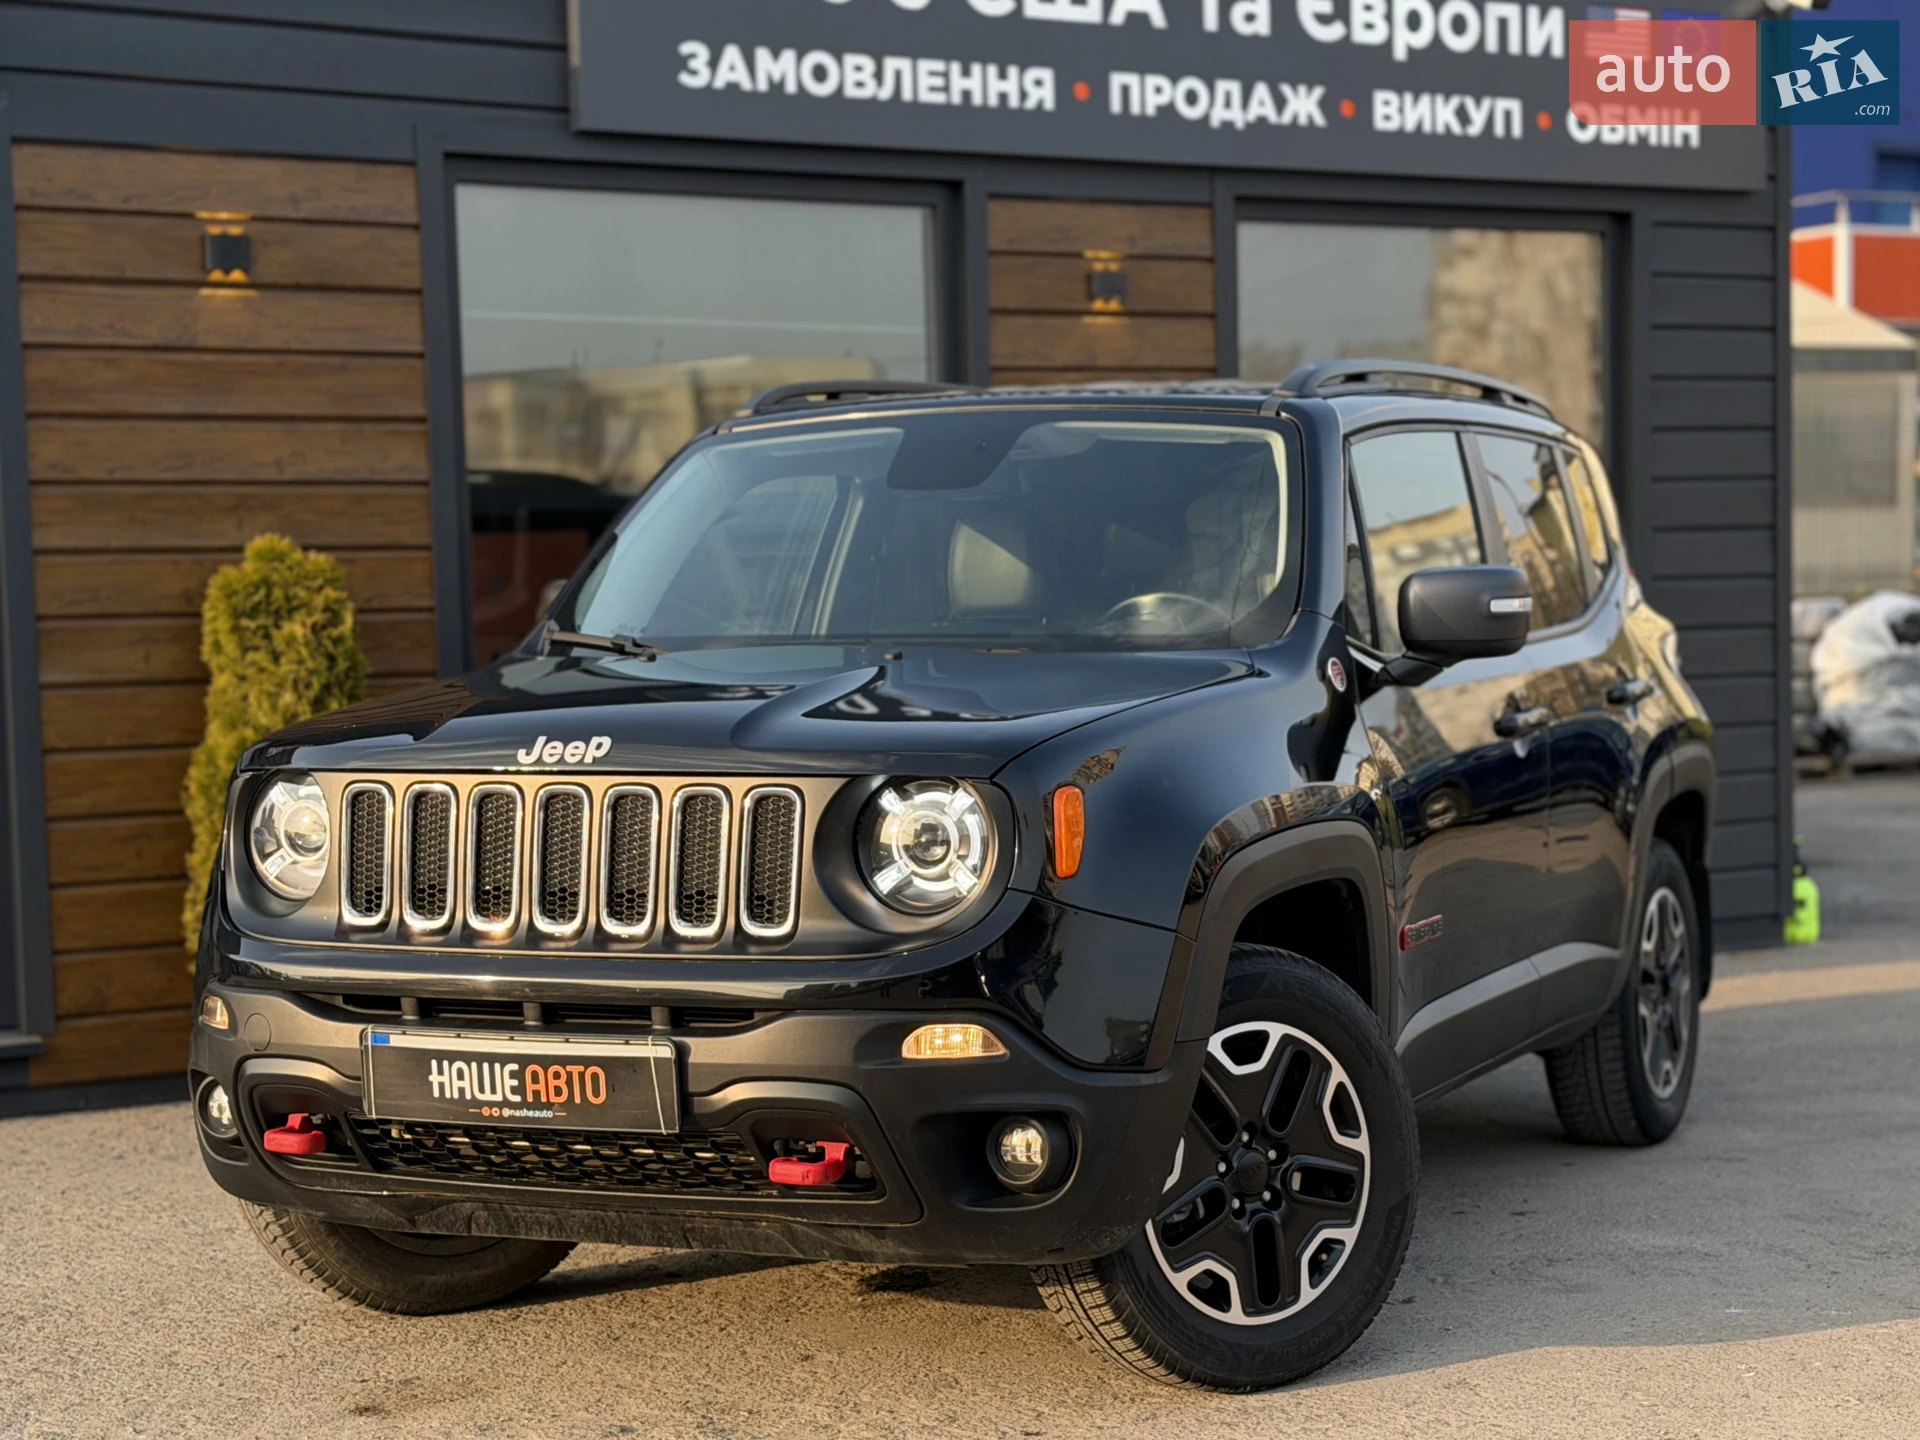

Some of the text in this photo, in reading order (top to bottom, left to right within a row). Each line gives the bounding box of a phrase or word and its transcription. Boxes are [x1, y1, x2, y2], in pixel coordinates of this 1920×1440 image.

[1299, 0, 1565, 61] Європи
[677, 40, 1701, 149] ЗАМОВЛЕННЯ ПРОДАЖ ВИКУП ОБМІН
[516, 736, 612, 764] Jeep
[428, 1059, 607, 1105] НАШЕ АВТО
[501, 1107, 554, 1118] @nasheauto
